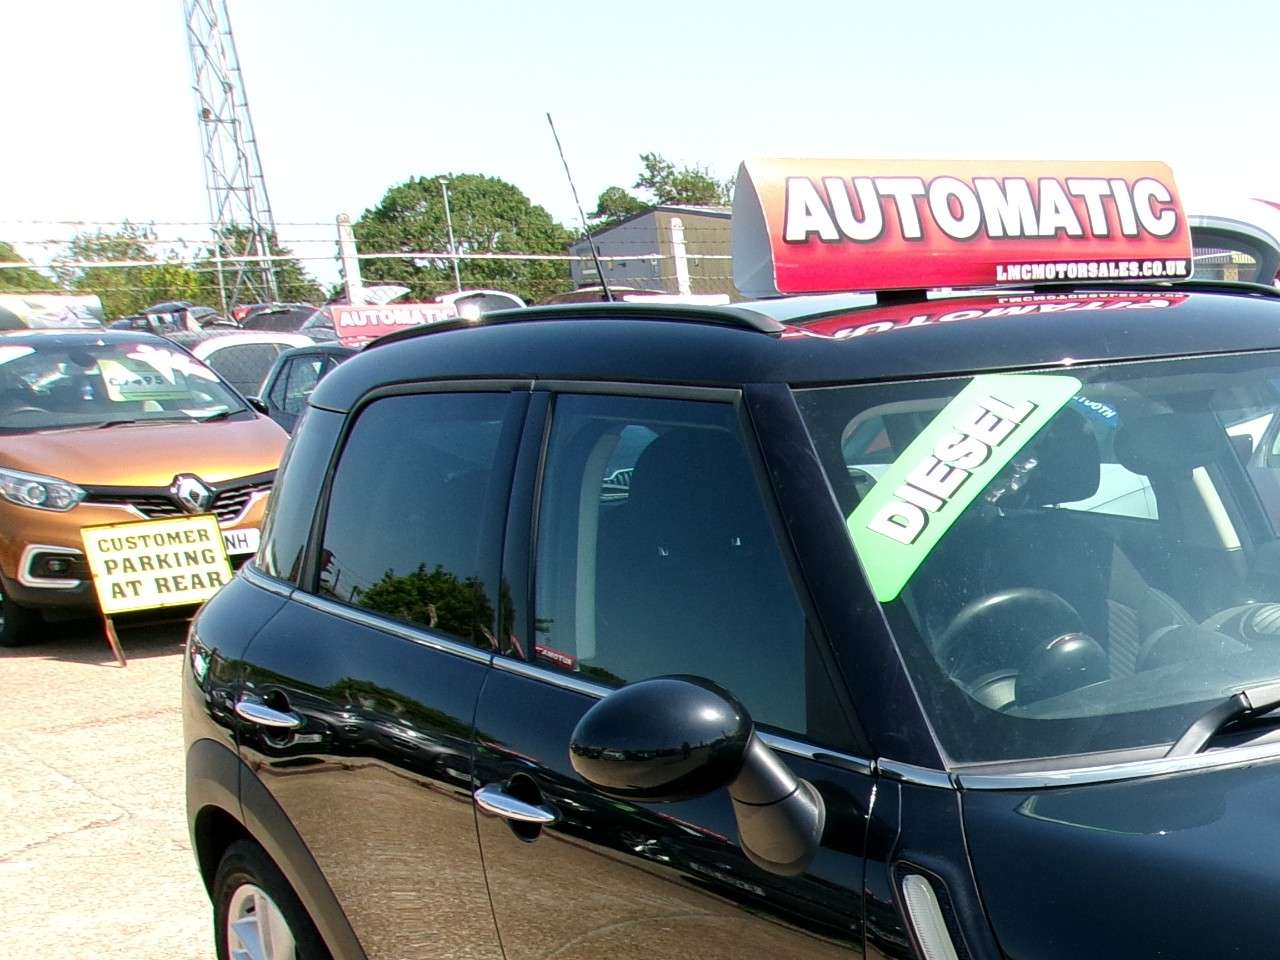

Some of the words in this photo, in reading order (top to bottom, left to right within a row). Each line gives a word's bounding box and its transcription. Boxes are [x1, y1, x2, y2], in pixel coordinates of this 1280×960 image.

[785, 175, 1178, 243] AUTOMATIC
[996, 260, 1187, 281] LMCMOTORSALES.CO.UK
[866, 393, 1039, 545] DIESEL
[98, 528, 211, 553] CUSTOMER
[104, 549, 217, 576] PARKING
[111, 580, 143, 600] AT
[154, 571, 224, 595] REAR
